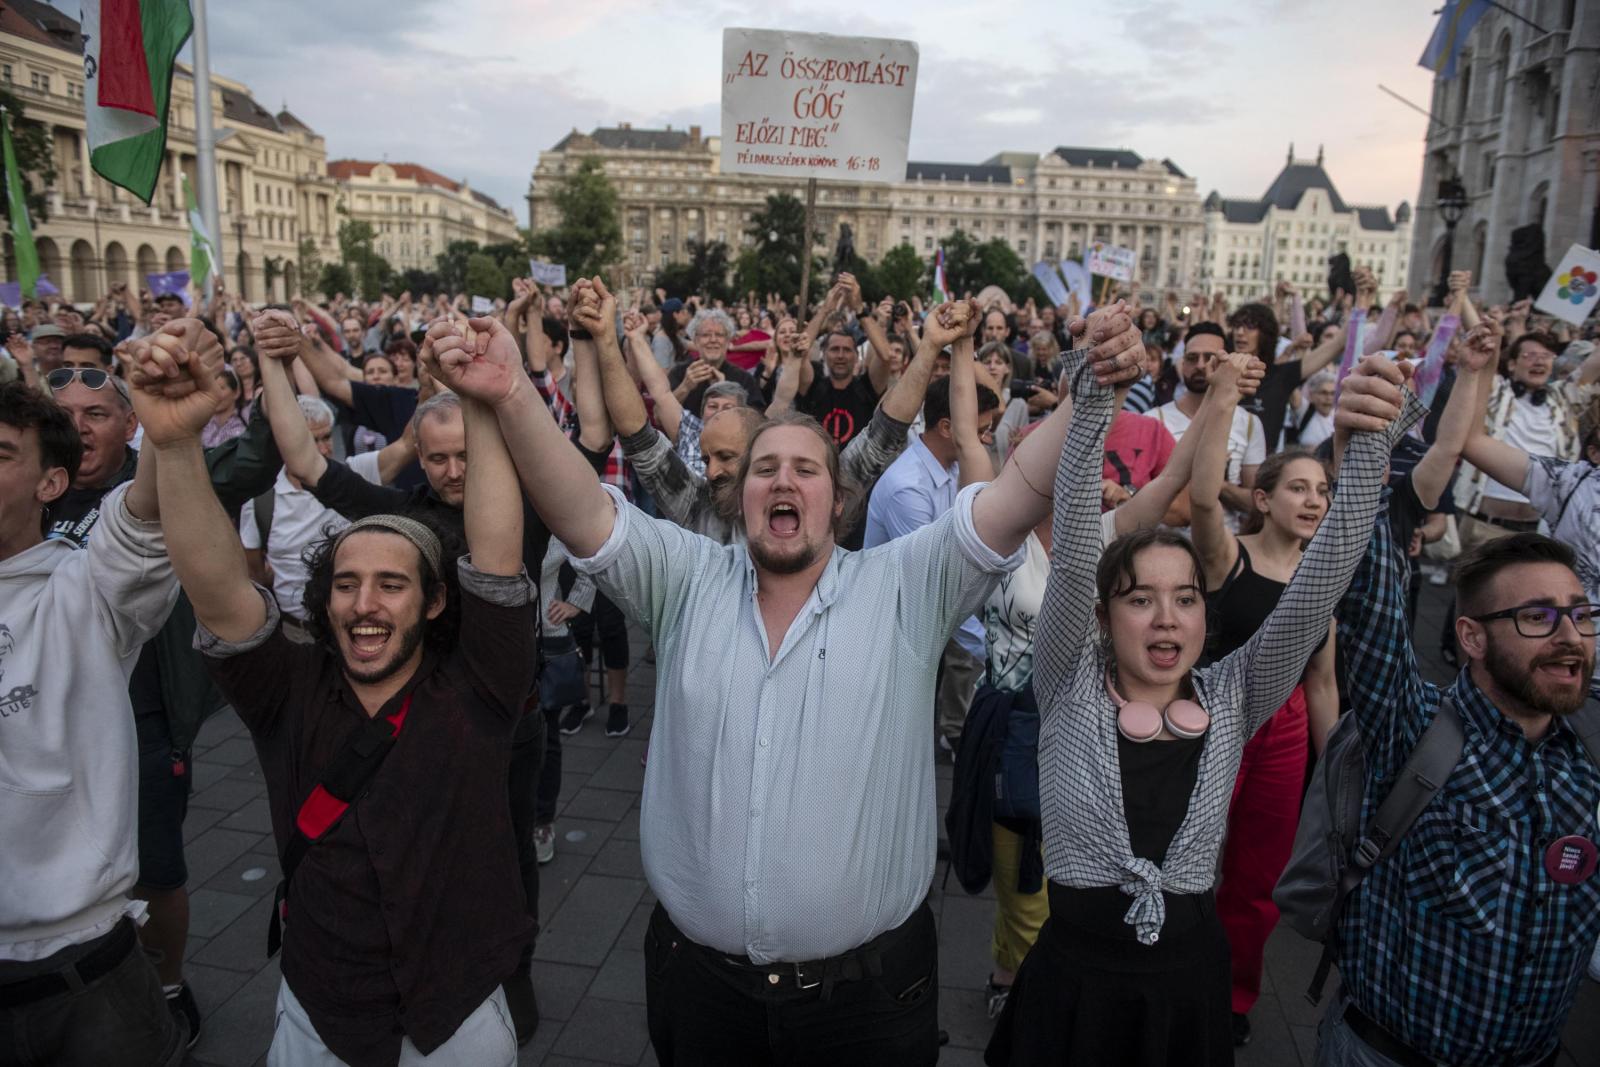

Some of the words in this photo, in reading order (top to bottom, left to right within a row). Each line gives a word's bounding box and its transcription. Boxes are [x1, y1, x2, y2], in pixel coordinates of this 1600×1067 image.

[780, 51, 910, 87] ÖSSZEOMLÁST
[793, 83, 846, 120] GŐG
[735, 117, 785, 145] ELŐZI
[0, 698, 31, 718] LUB
